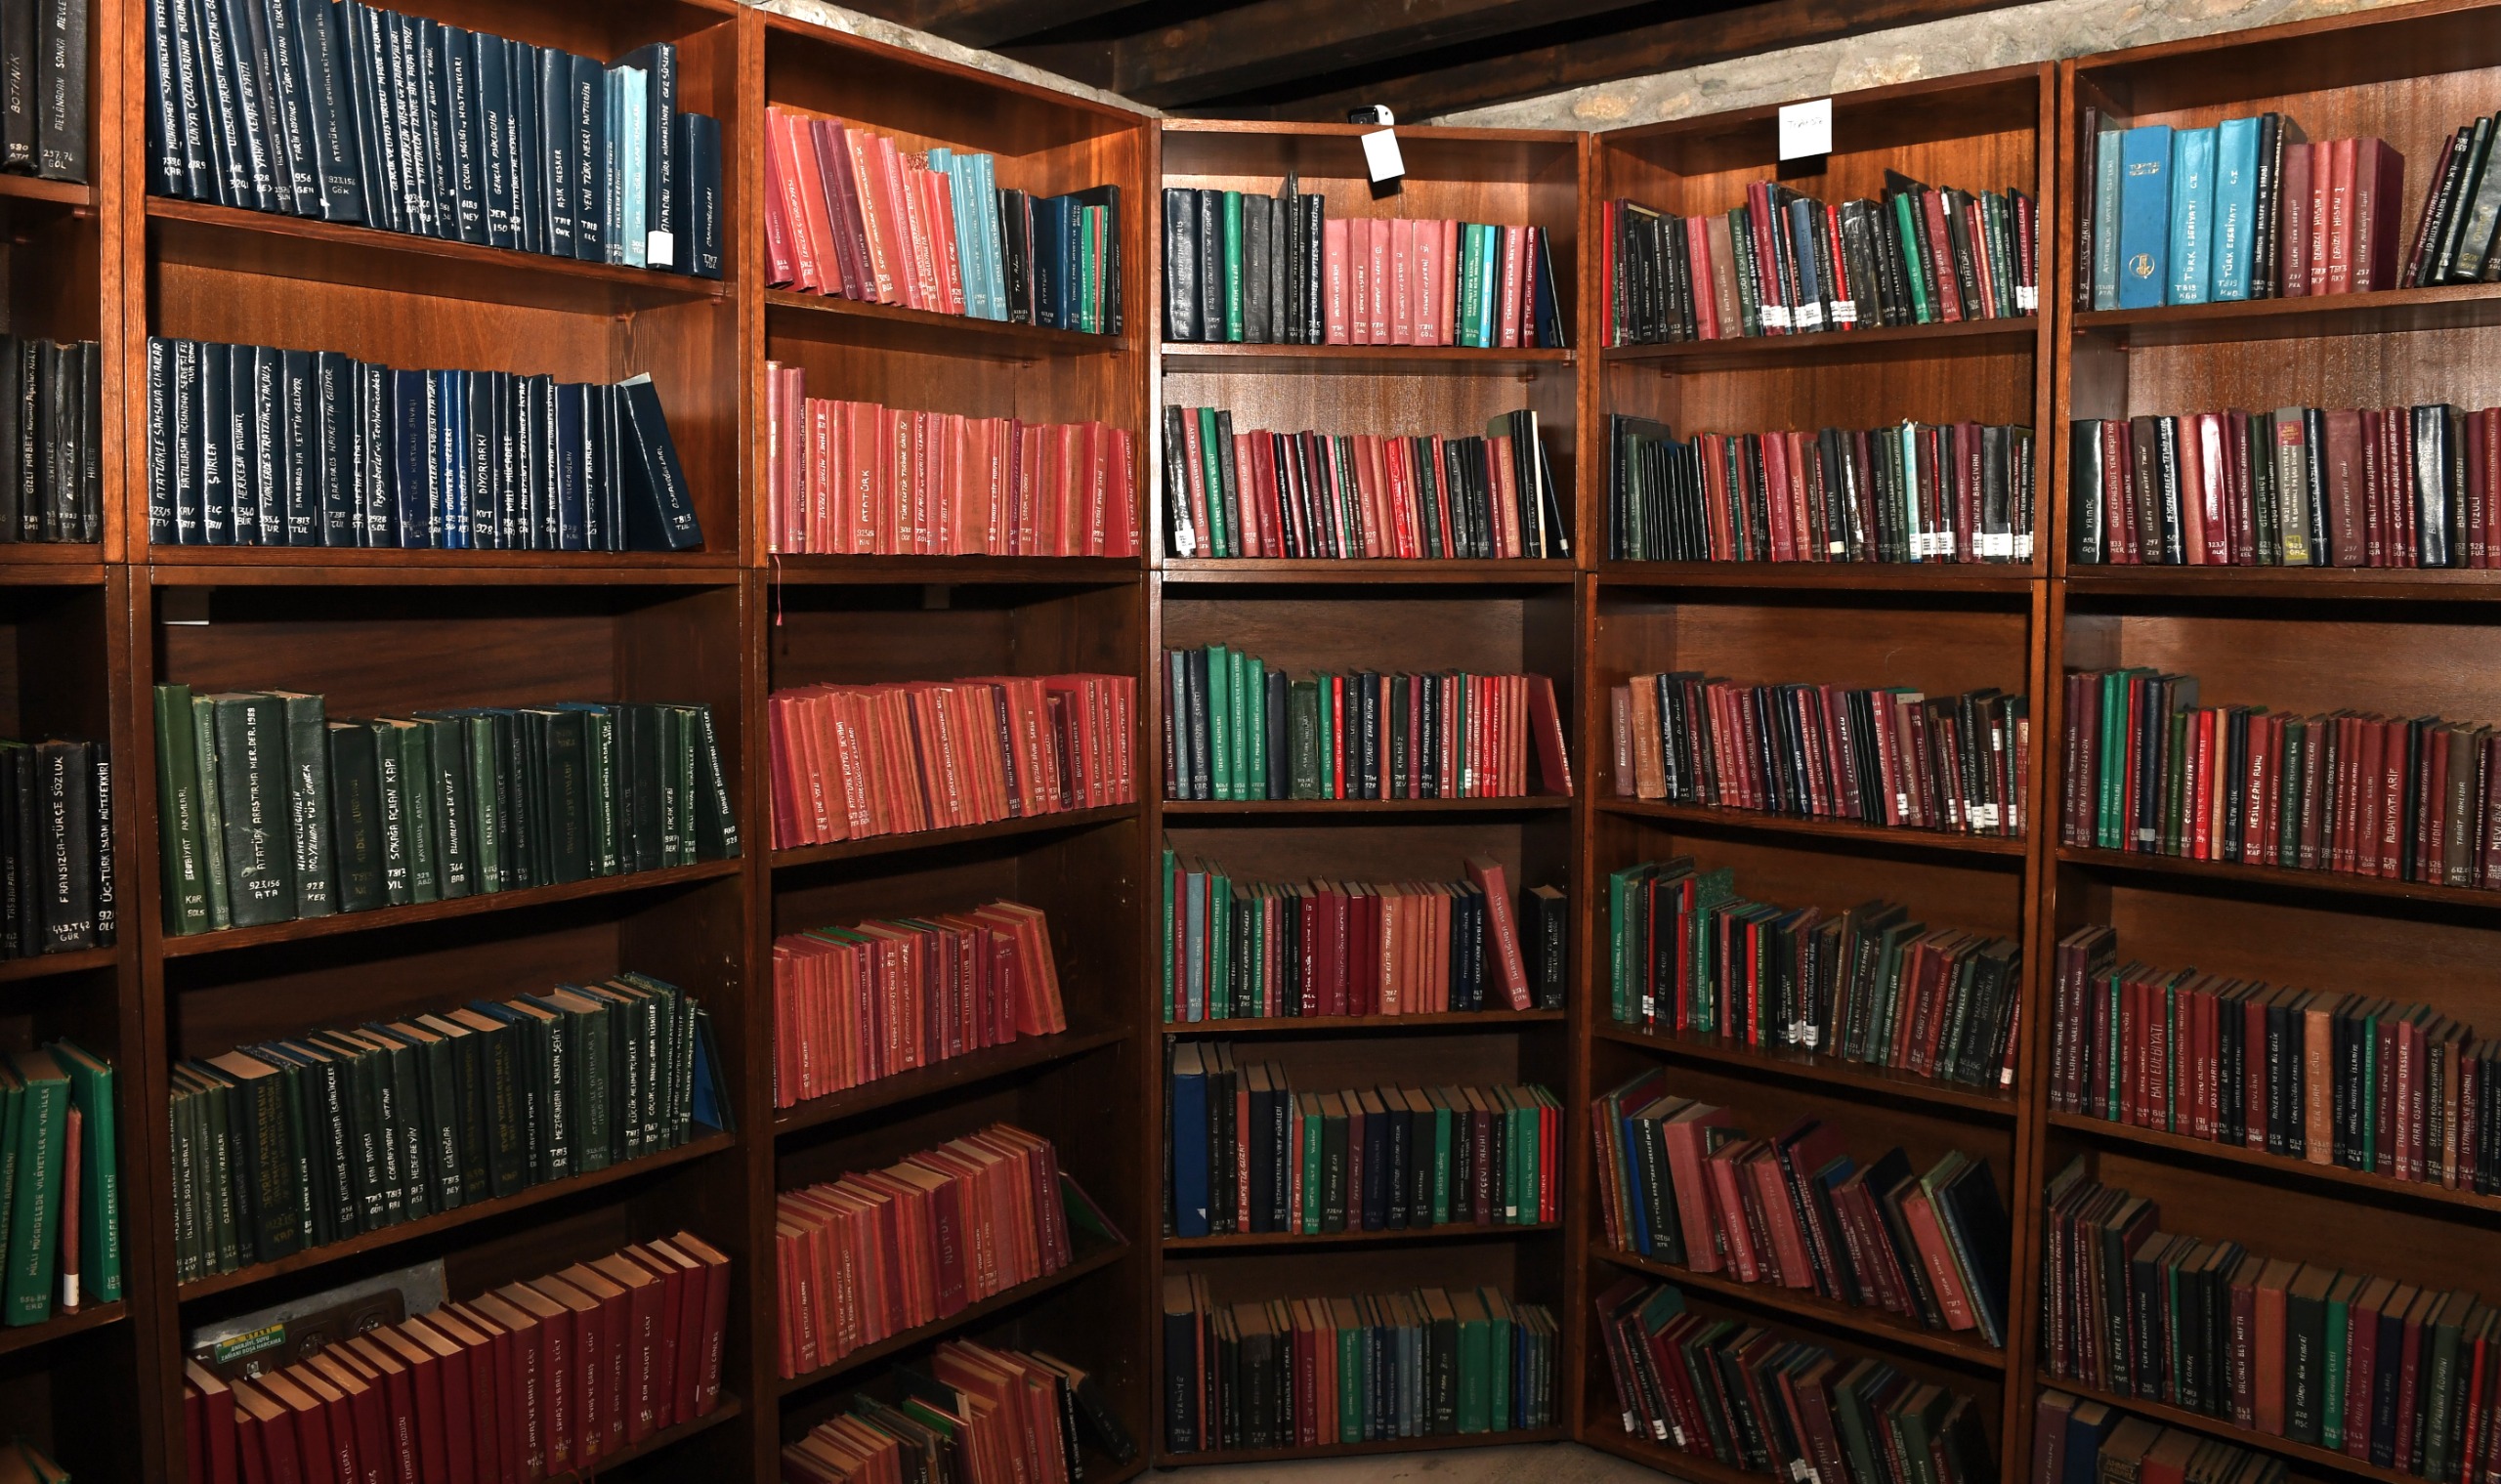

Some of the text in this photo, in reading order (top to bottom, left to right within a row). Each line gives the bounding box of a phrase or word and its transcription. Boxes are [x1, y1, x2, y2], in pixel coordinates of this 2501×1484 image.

[55, 37, 65, 69] SONRA
[403, 55, 414, 77] ARPA
[7, 53, 21, 114] BOTANİK
[181, 38, 197, 108] ÇOCUKLARININ
[404, 80, 416, 96] BİR
[218, 74, 233, 104] ARASI
[164, 100, 178, 149] MUHAMMED
[245, 102, 267, 169] YAHYA KEMAL
[287, 101, 304, 162] TARİH BOYUNCA
[10, 143, 28, 151] 580
[328, 120, 342, 162] ATATÜRK
[253, 174, 270, 183] 928
[294, 173, 312, 183] 956
[462, 162, 473, 191] ÇOCUK
[581, 129, 593, 211] YENİ TÜRK NESRİ
[660, 160, 670, 183] TÜRK
[660, 189, 670, 232] ANADOLU
[2311, 197, 2322, 261] DENİZCİ HASAN
[2331, 197, 2342, 259] DENİZCİ HASAN
[2183, 250, 2196, 280] TÜRK
[2221, 251, 2234, 278] TÜRK
[152, 342, 166, 500] ATATÜRKLE SAMSUNA ÇIKANLAR
[476, 434, 487, 494] DİYORLARKİ
[503, 436, 514, 483] MÜCADELE
[23, 471, 34, 494] GİZLİ
[329, 456, 341, 500] BARBAROS
[860, 469, 870, 523] ATATÜRK
[476, 509, 494, 518] KUT
[476, 523, 493, 532] 928
[301, 764, 316, 795] ÖRNEK
[385, 758, 396, 783] KAPI
[2252, 755, 2263, 777] RUHU
[2386, 767, 2398, 790] ARİF
[444, 770, 455, 806] DEVLET
[99, 824, 110, 852] İSLAM
[447, 819, 459, 854] BUNALIM
[485, 804, 493, 846] ANKARA
[251, 827, 267, 870] ATATÜRK
[388, 824, 401, 860] SOKAĞA
[186, 894, 203, 905] KAR
[254, 889, 279, 899] ATA
[306, 881, 325, 890] 928
[307, 893, 327, 902] KER
[388, 880, 403, 890] YIL
[551, 1028, 564, 1053] ŞEHİT
[553, 1055, 562, 1084] KALKAN
[2150, 1077, 2162, 1098] BATI
[2413, 1090, 2422, 1120] OSMAN
[39, 1127, 47, 1137] VE
[364, 1132, 378, 1183] KAN DAVASI
[218, 1132, 231, 1224] OZANLAR VE YAZARLAR
[2236, 1315, 2245, 1340] HAFTA
